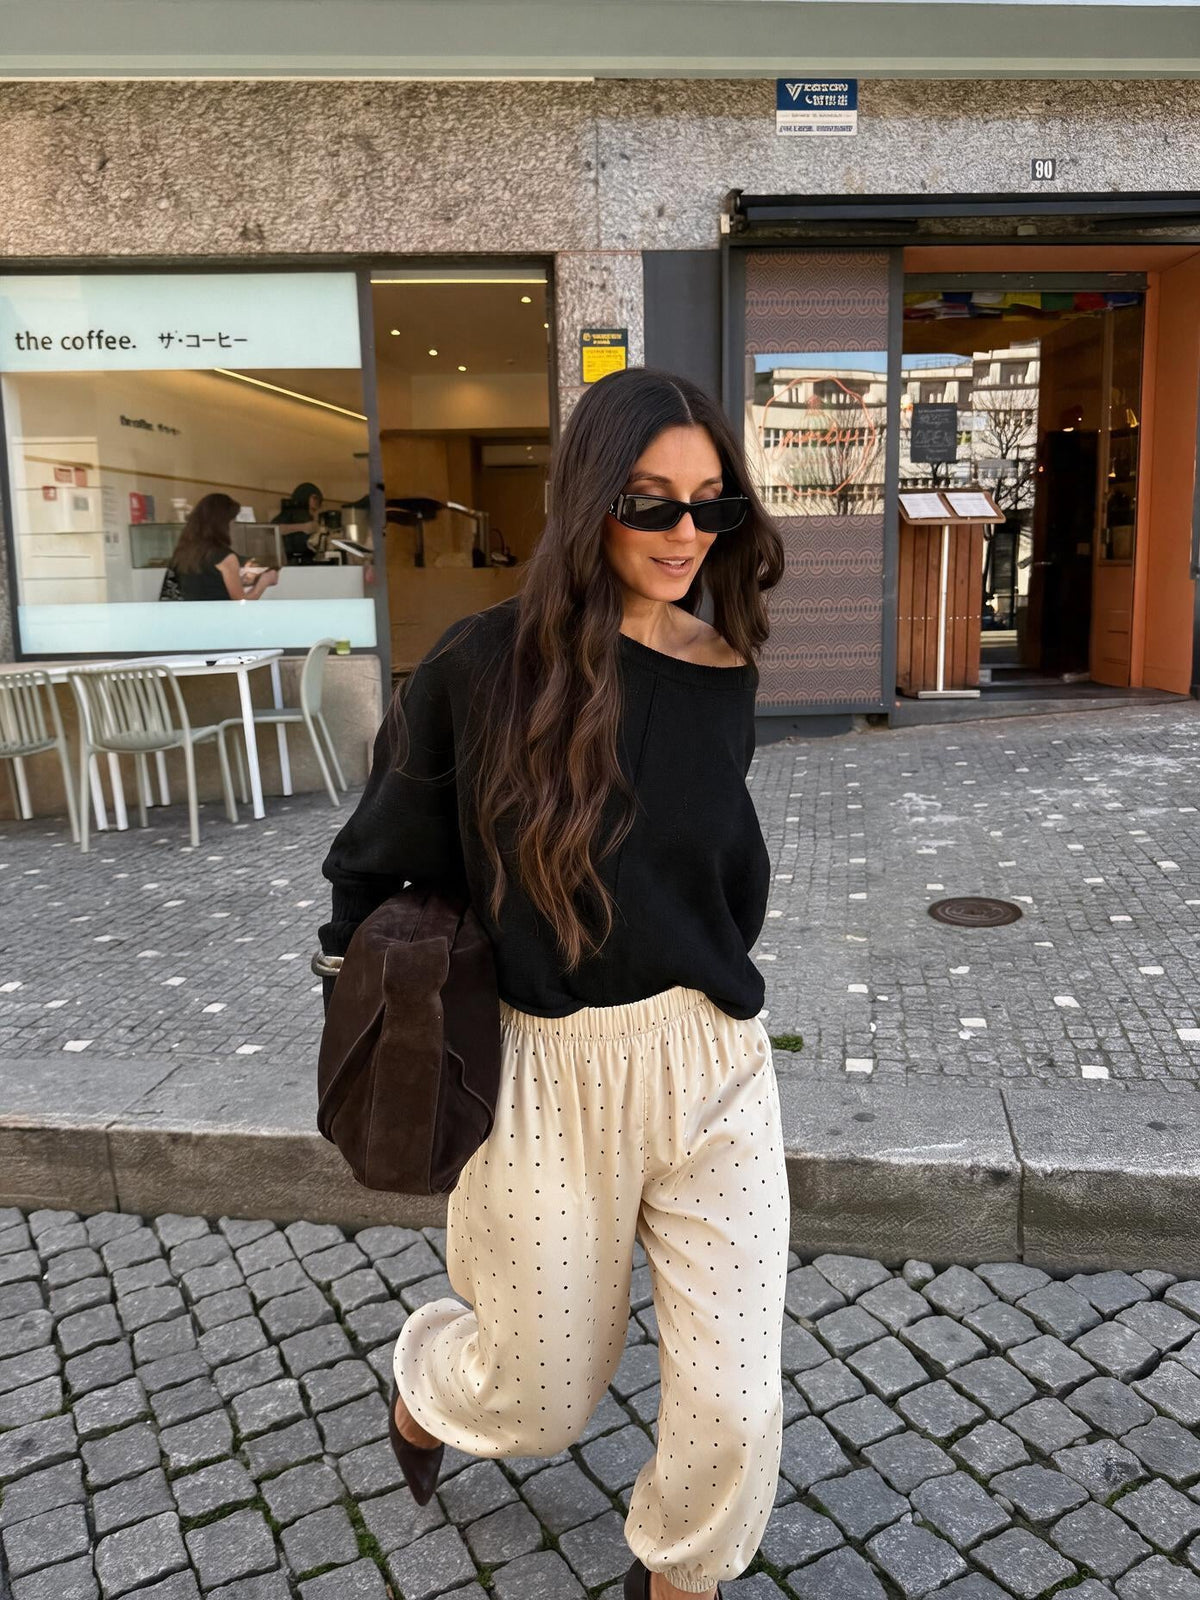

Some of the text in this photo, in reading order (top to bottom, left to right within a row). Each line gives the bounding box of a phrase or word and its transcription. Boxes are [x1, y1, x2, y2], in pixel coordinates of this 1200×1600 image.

[1035, 160, 1053, 179] 80
[15, 329, 137, 351] the coffee.
